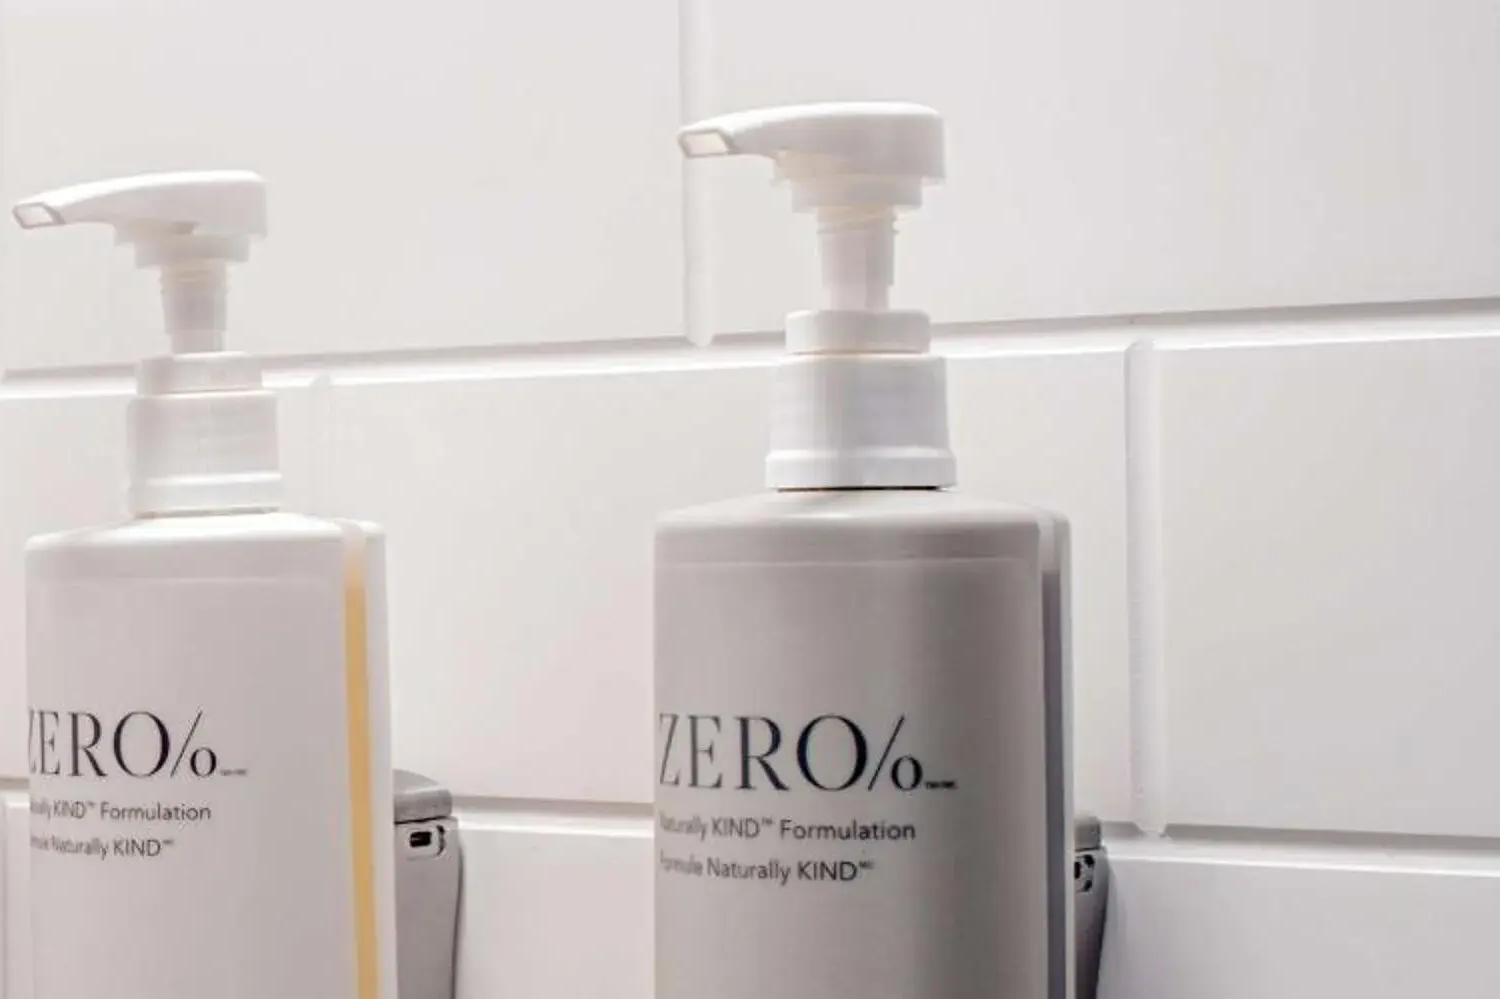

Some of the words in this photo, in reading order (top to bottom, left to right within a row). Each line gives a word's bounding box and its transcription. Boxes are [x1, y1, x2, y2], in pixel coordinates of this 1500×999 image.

[659, 712, 923, 792] ZERO%
[100, 801, 212, 821] Formulation
[779, 818, 916, 842] Formulation
[706, 856, 792, 887] Naturally
